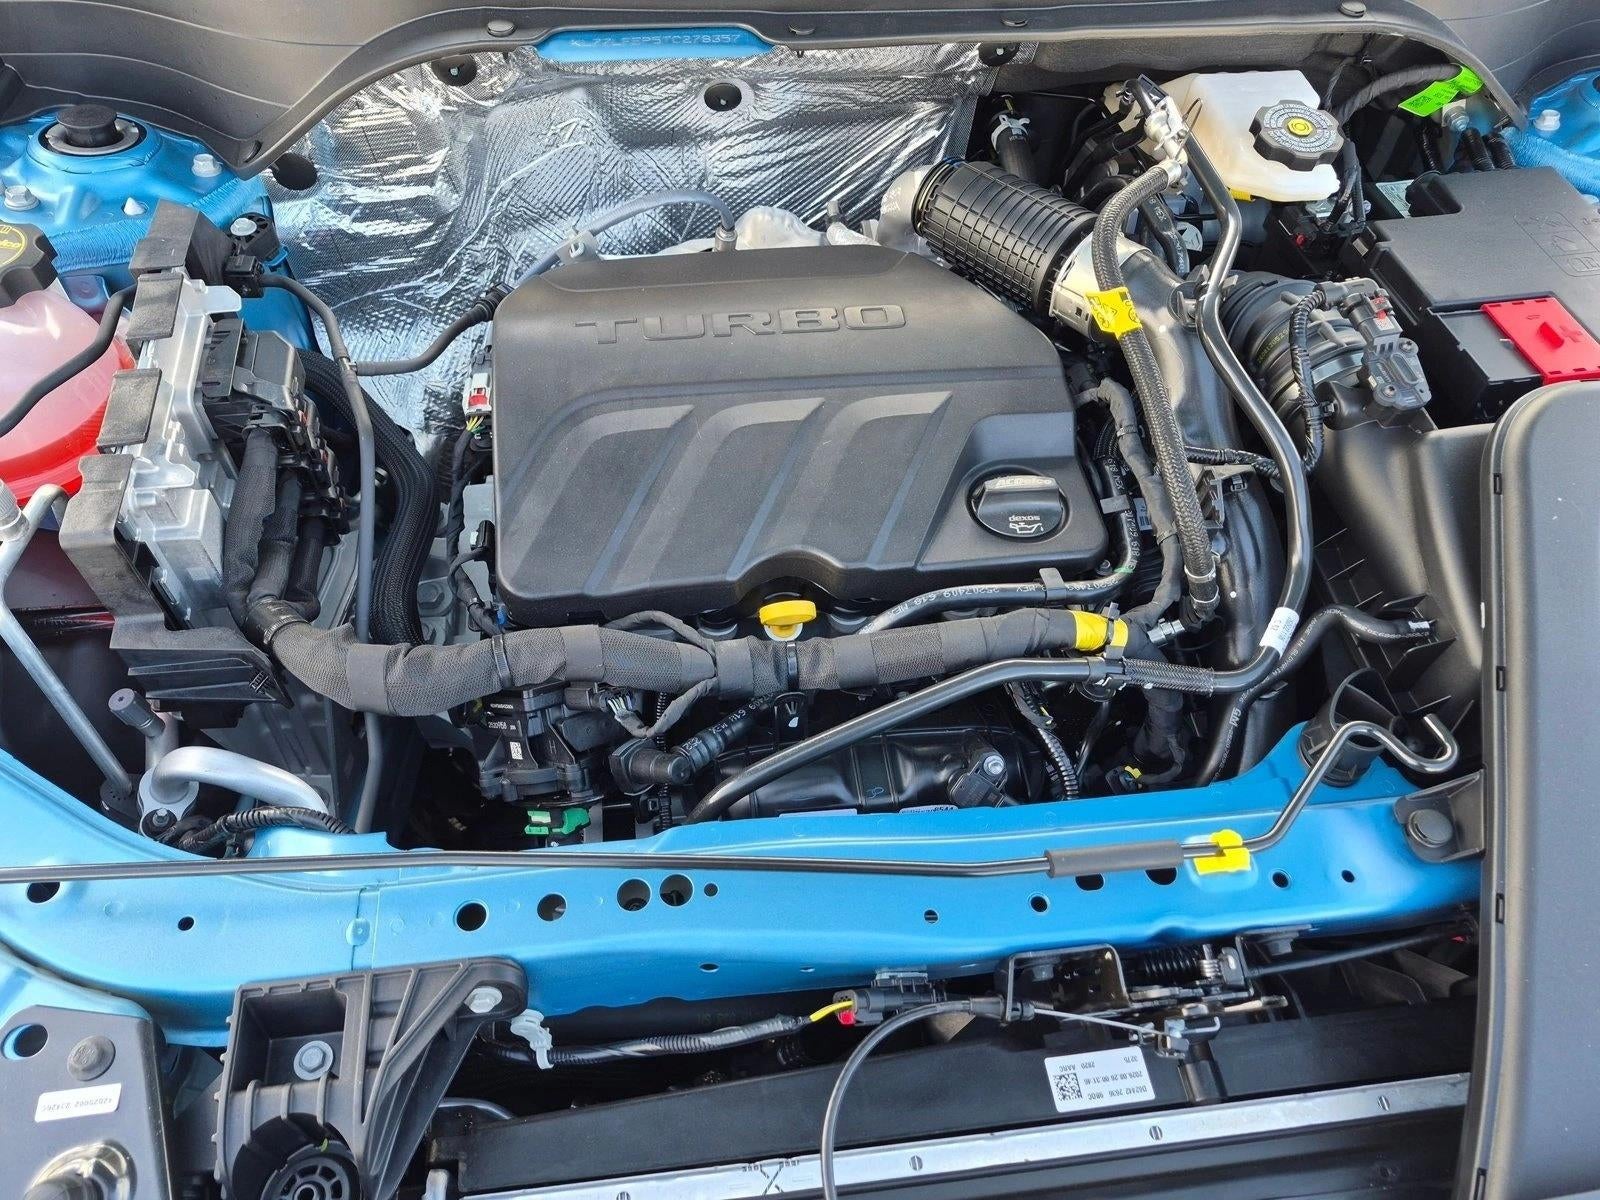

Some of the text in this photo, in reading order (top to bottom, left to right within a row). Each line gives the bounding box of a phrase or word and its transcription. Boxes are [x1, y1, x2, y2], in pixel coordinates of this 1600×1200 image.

[574, 304, 906, 344] TURBO
[1008, 514, 1041, 522] dexos
[1229, 706, 1242, 728] GM
